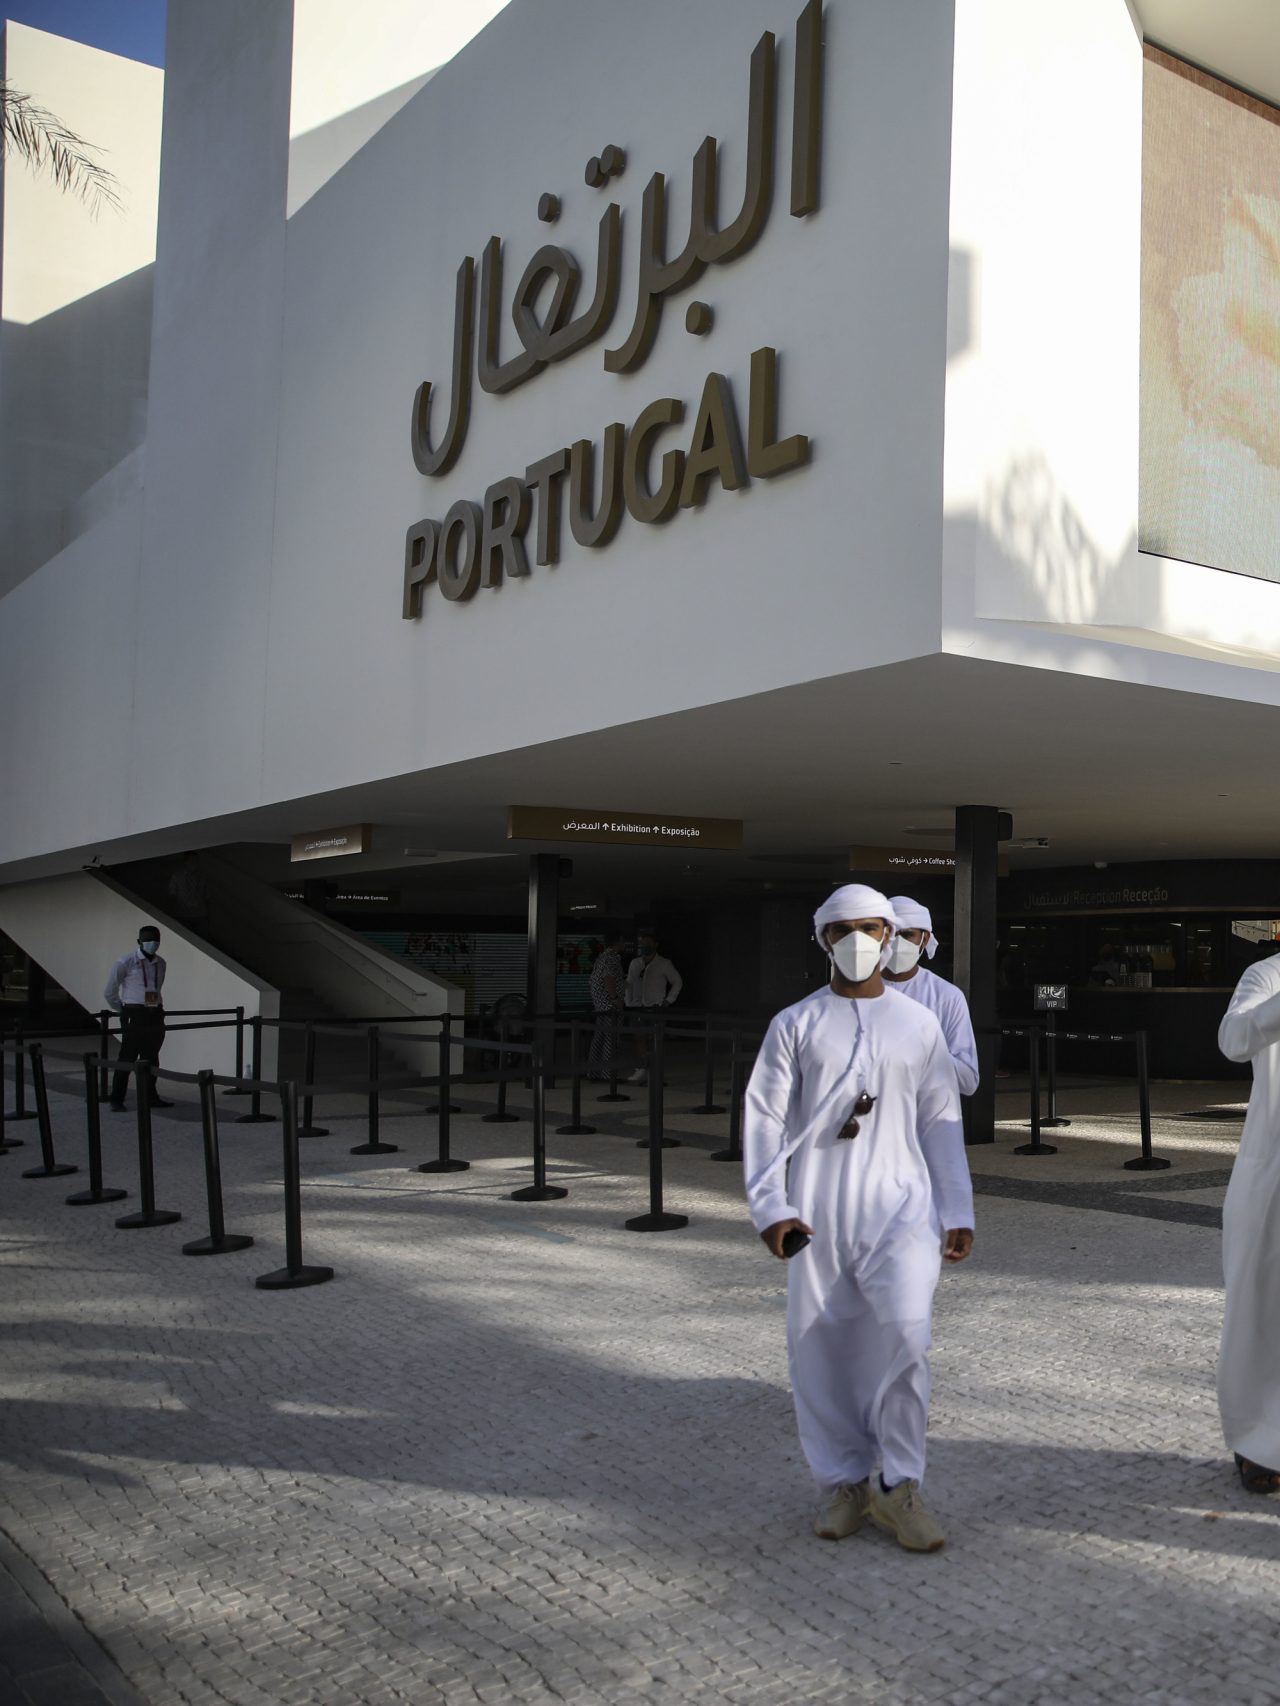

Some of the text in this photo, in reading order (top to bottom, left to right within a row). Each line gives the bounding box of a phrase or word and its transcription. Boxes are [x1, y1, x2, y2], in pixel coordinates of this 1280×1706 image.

[410, 0, 823, 477] البرتغال
[402, 346, 809, 620] PORTUGAL
[562, 820, 601, 831] المعرض
[611, 823, 700, 838] Exhibition Exposição
[928, 857, 956, 866] Coffee Sho
[1122, 887, 1168, 905] Receção
[1046, 1000, 1057, 1008] VIP
